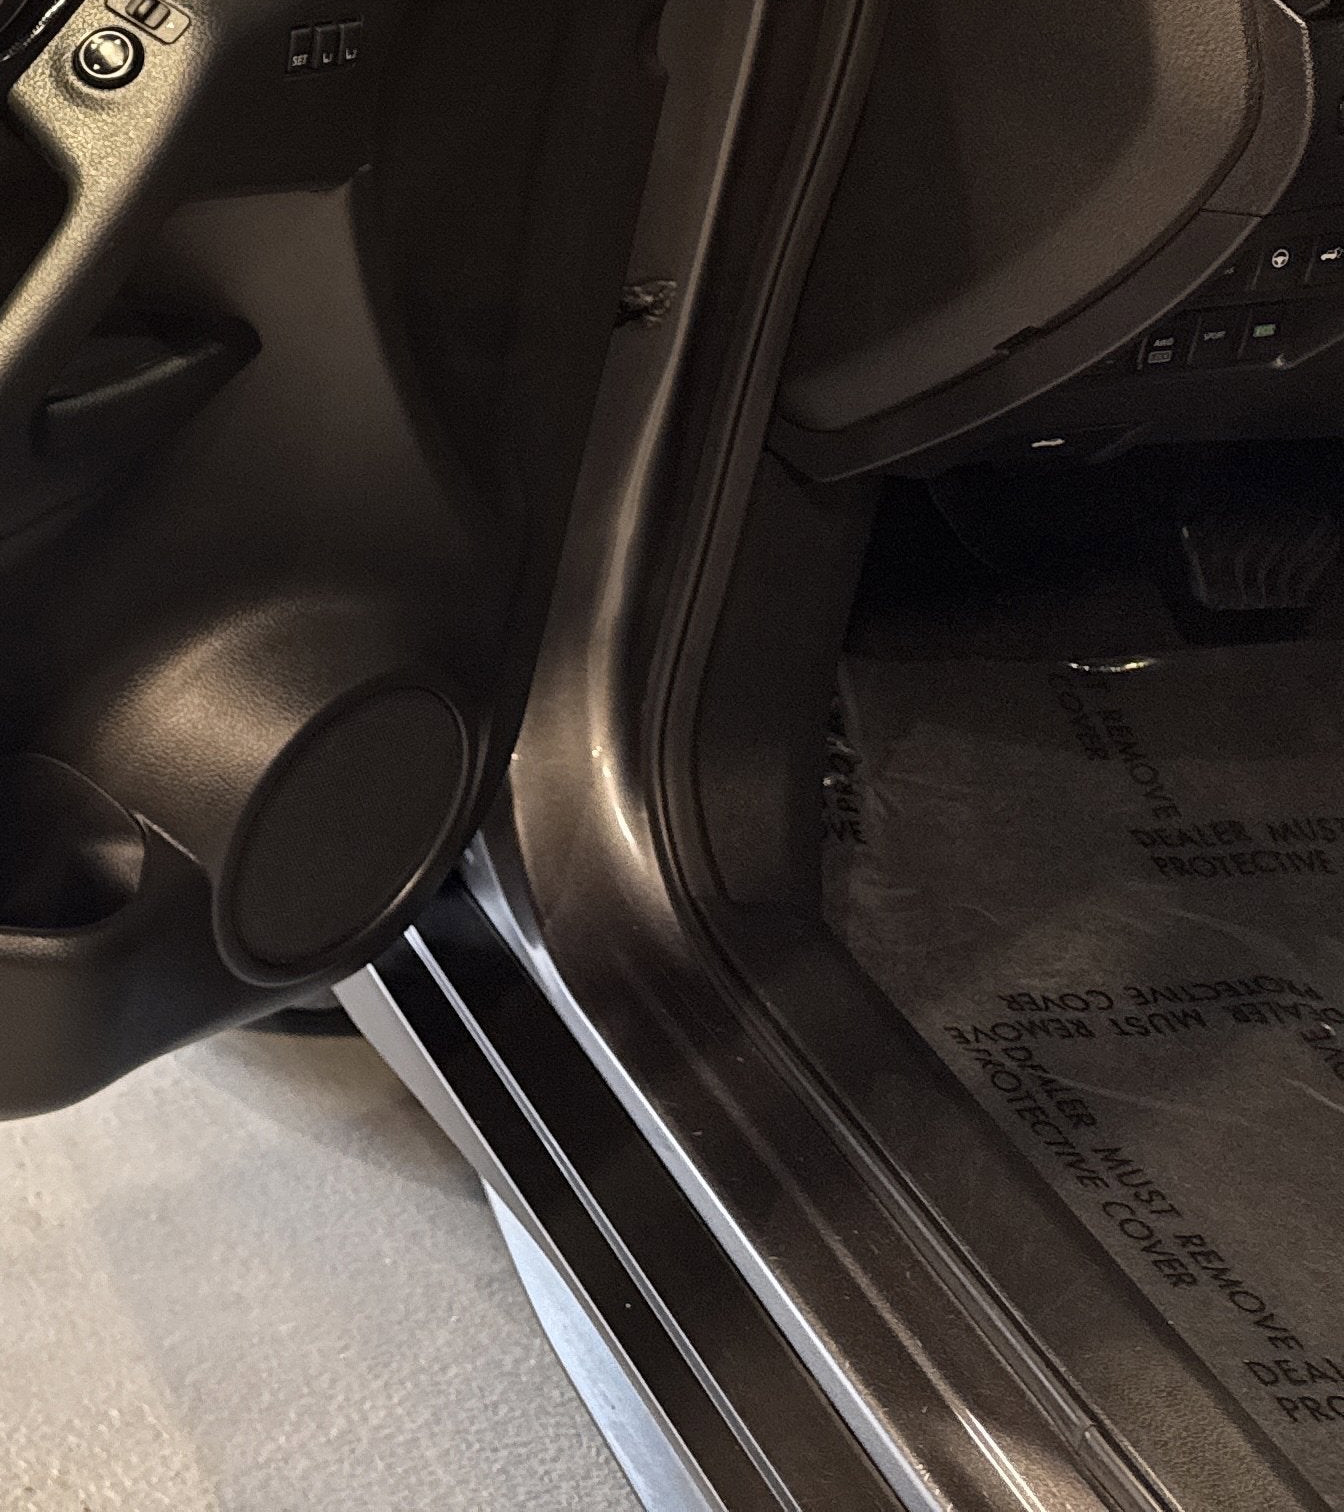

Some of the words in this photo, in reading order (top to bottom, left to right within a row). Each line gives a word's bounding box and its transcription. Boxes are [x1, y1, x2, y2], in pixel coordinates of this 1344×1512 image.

[292, 54, 308, 66] SET
[1127, 819, 1255, 849] DEALER
[1150, 848, 1340, 879] PROTECTIVE
[996, 988, 1115, 1014] COVER
[943, 1016, 1097, 1046] REMOVE
[1108, 1007, 1209, 1039] MUST
[963, 1046, 1112, 1190] PROTECTIVE
[1101, 1200, 1199, 1287] COVER
[1091, 1146, 1184, 1220] MUST
[1173, 1233, 1306, 1352] REMOVE
